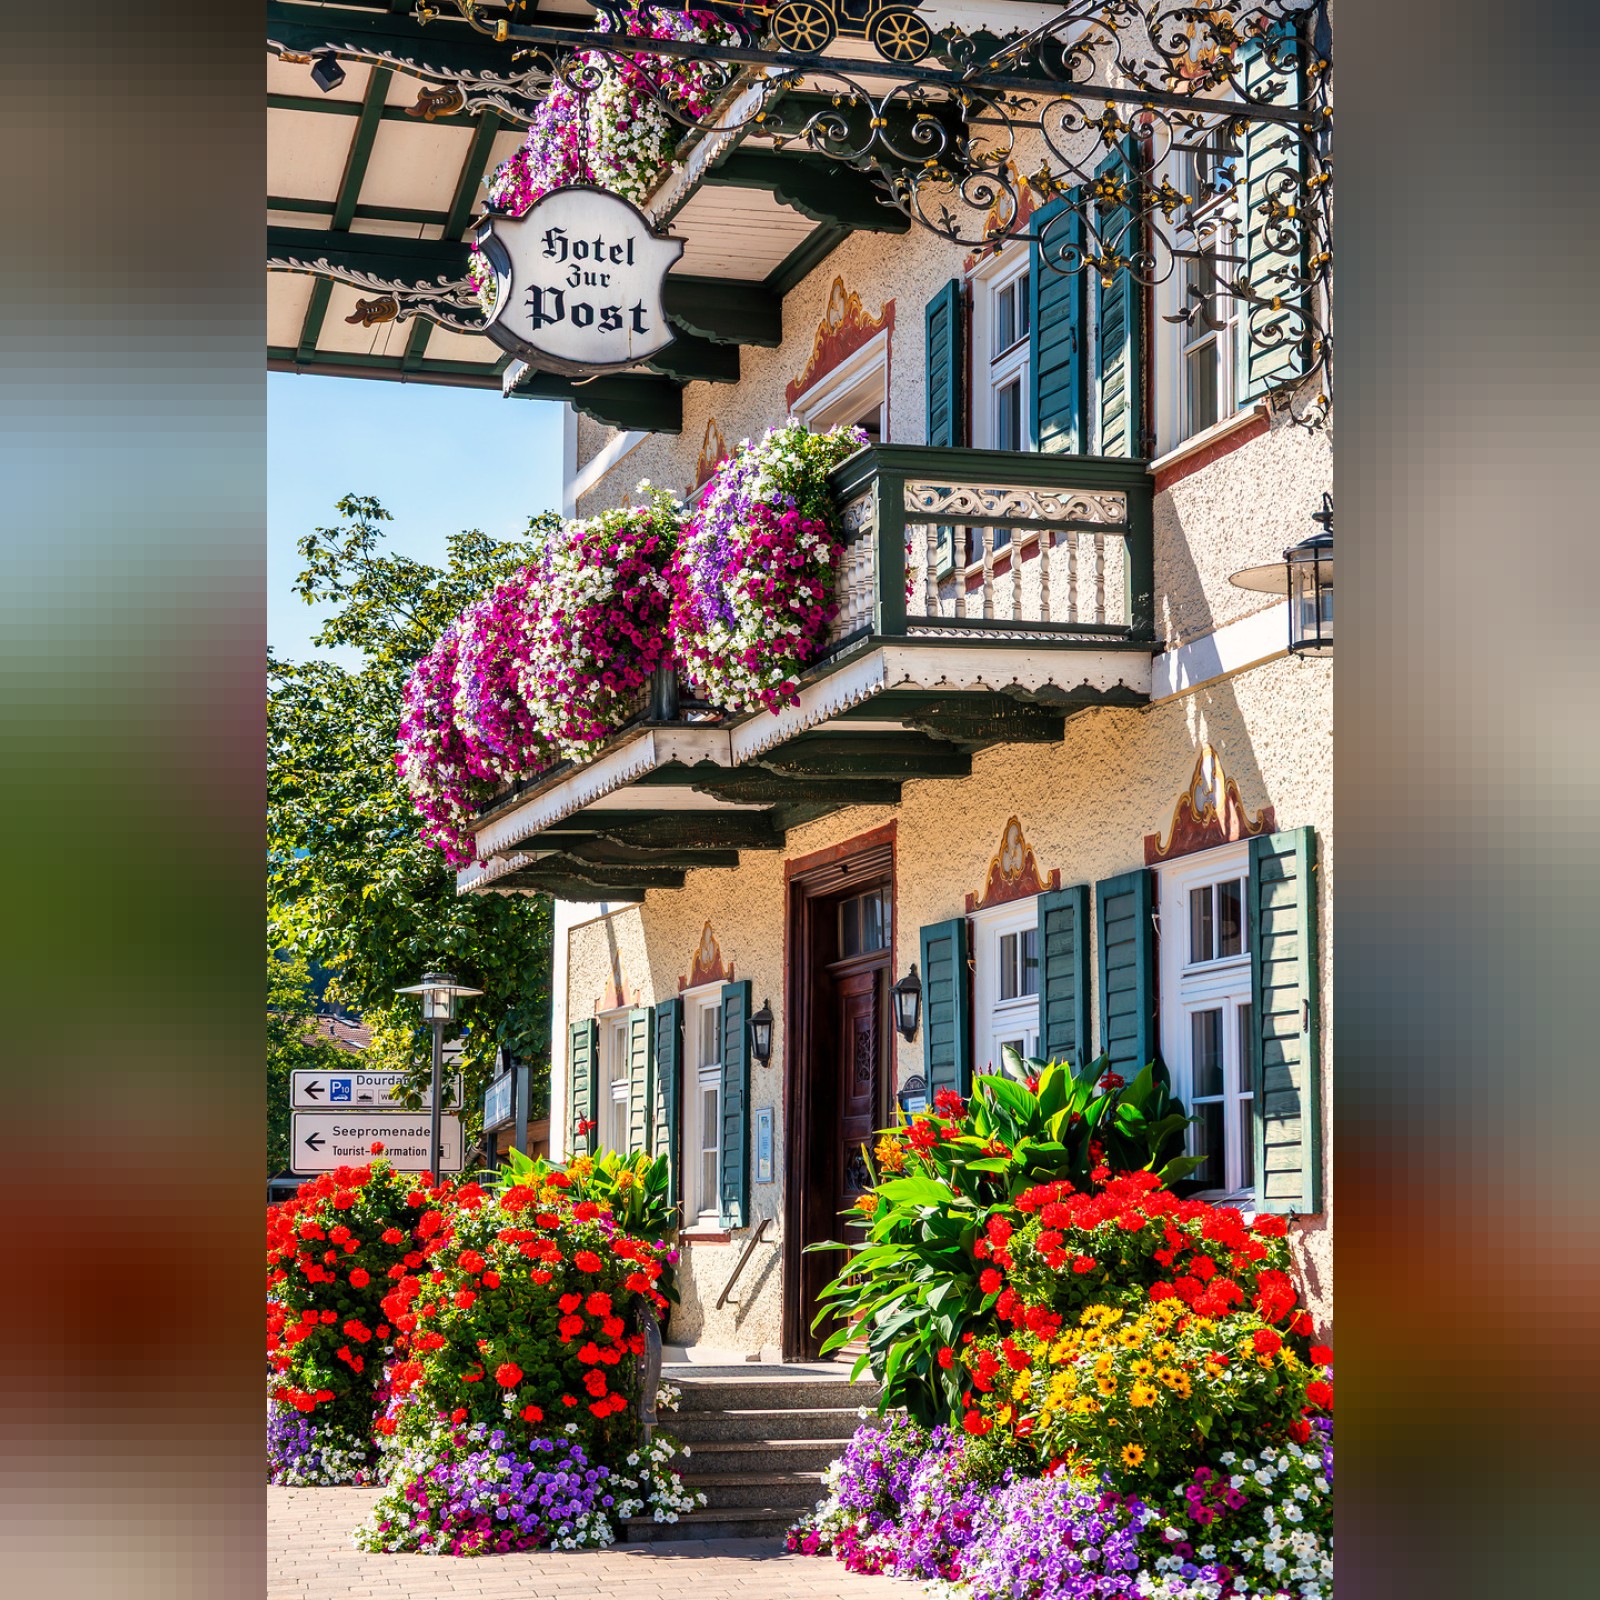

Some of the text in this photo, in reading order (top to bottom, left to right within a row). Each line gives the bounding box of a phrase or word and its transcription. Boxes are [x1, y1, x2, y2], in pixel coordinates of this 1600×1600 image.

[541, 226, 636, 266] Hotel
[524, 284, 650, 335] Post
[332, 1126, 431, 1139] Seepromenade
